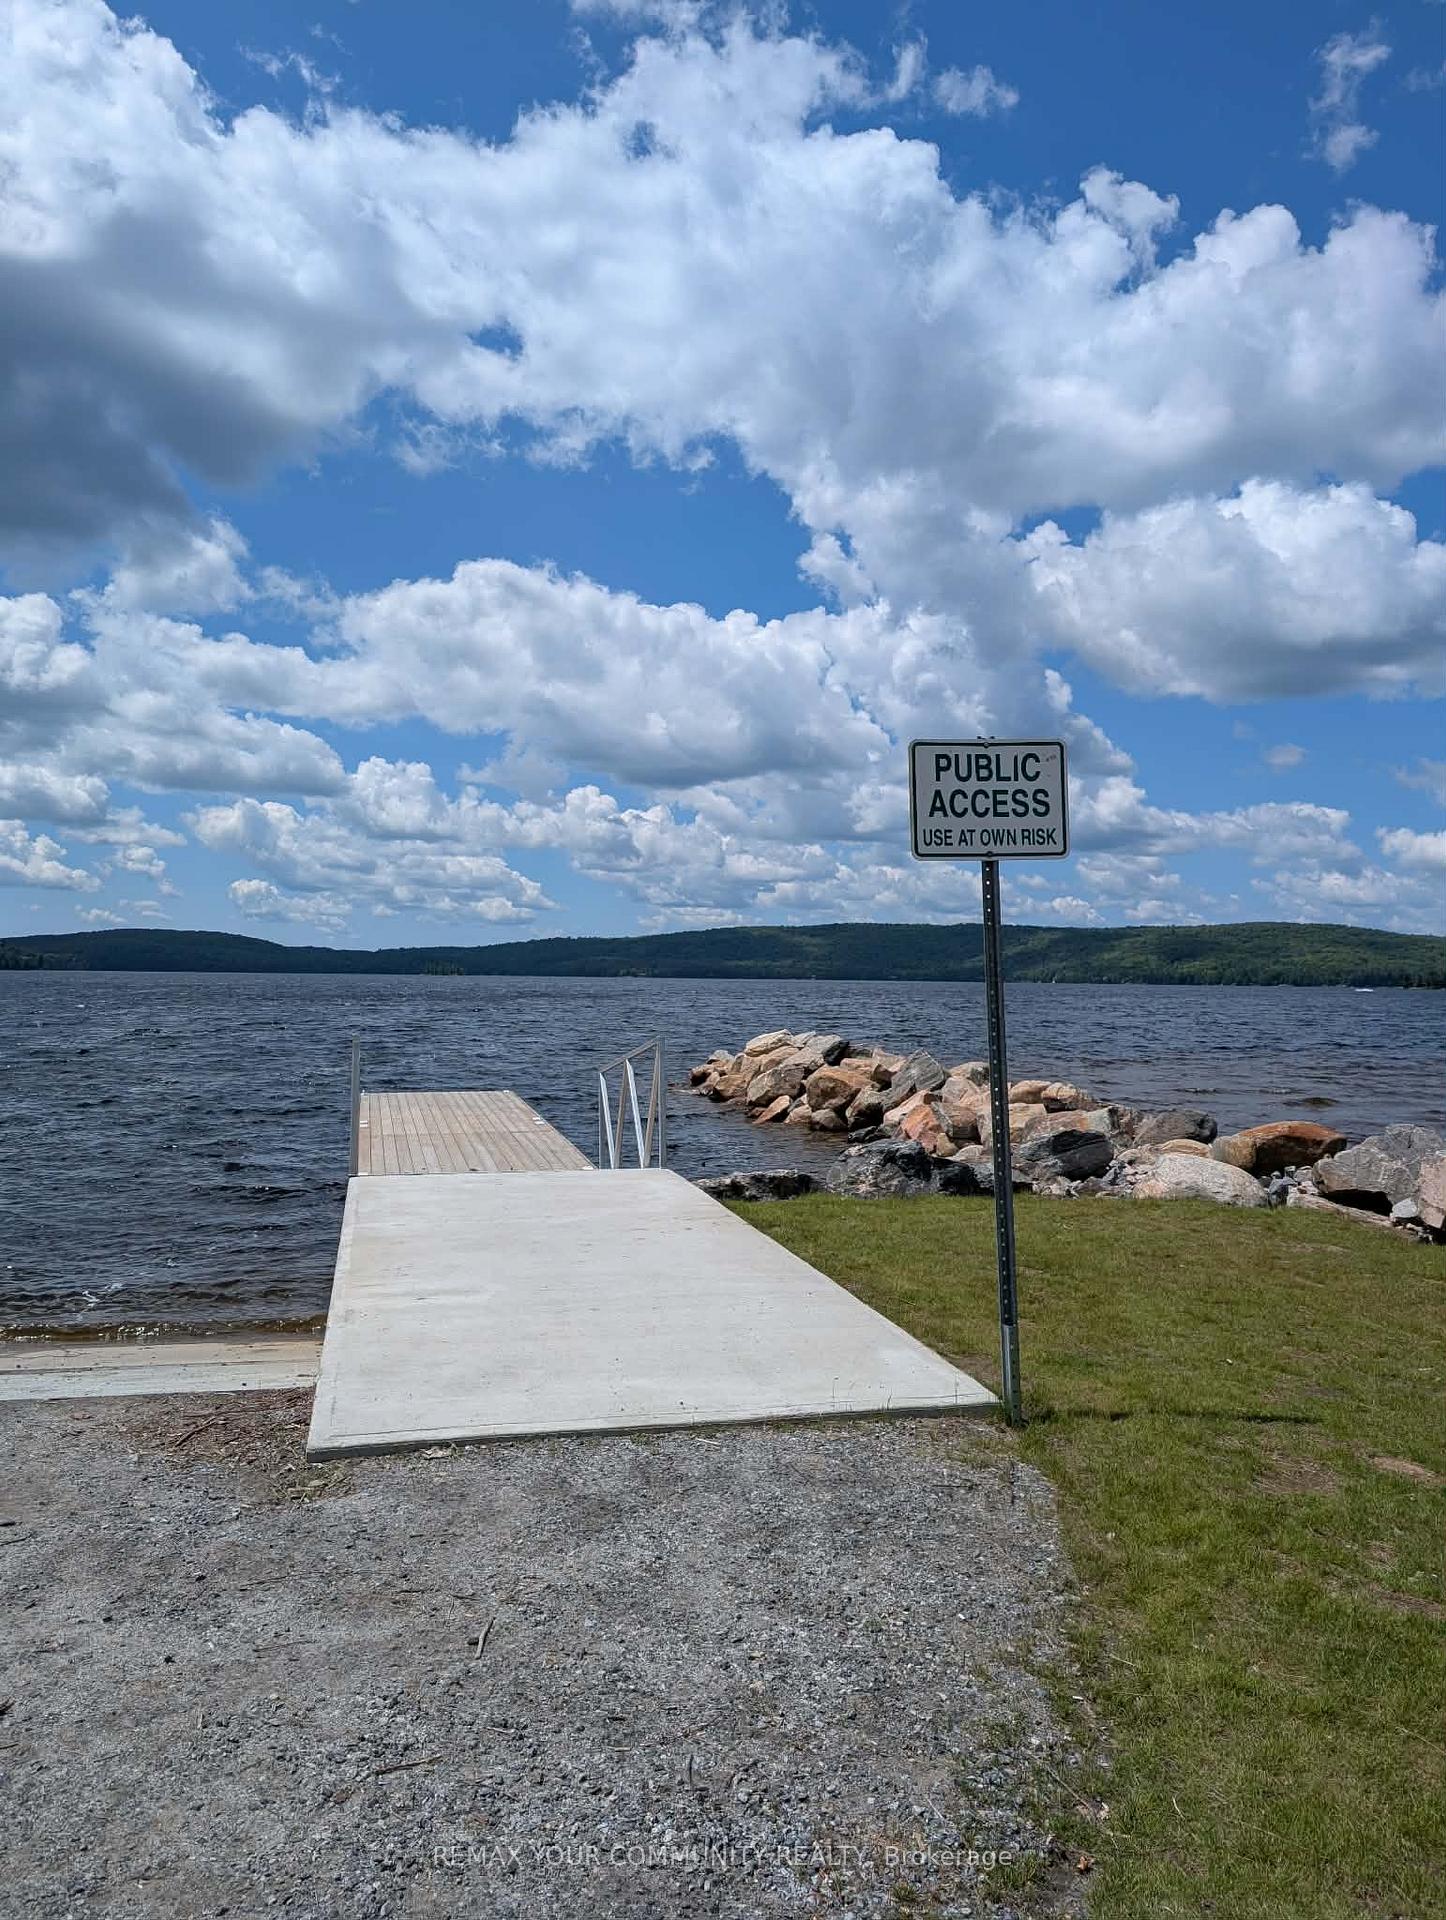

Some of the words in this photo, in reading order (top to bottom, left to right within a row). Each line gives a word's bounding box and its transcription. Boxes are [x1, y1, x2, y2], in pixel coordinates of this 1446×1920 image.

[935, 753, 1041, 782] PUBLIC
[929, 789, 1050, 818] ACCESS
[923, 829, 953, 847] USE
[958, 829, 976, 847] AT
[980, 829, 1017, 846] OWN
[1021, 828, 1057, 846] RISK
